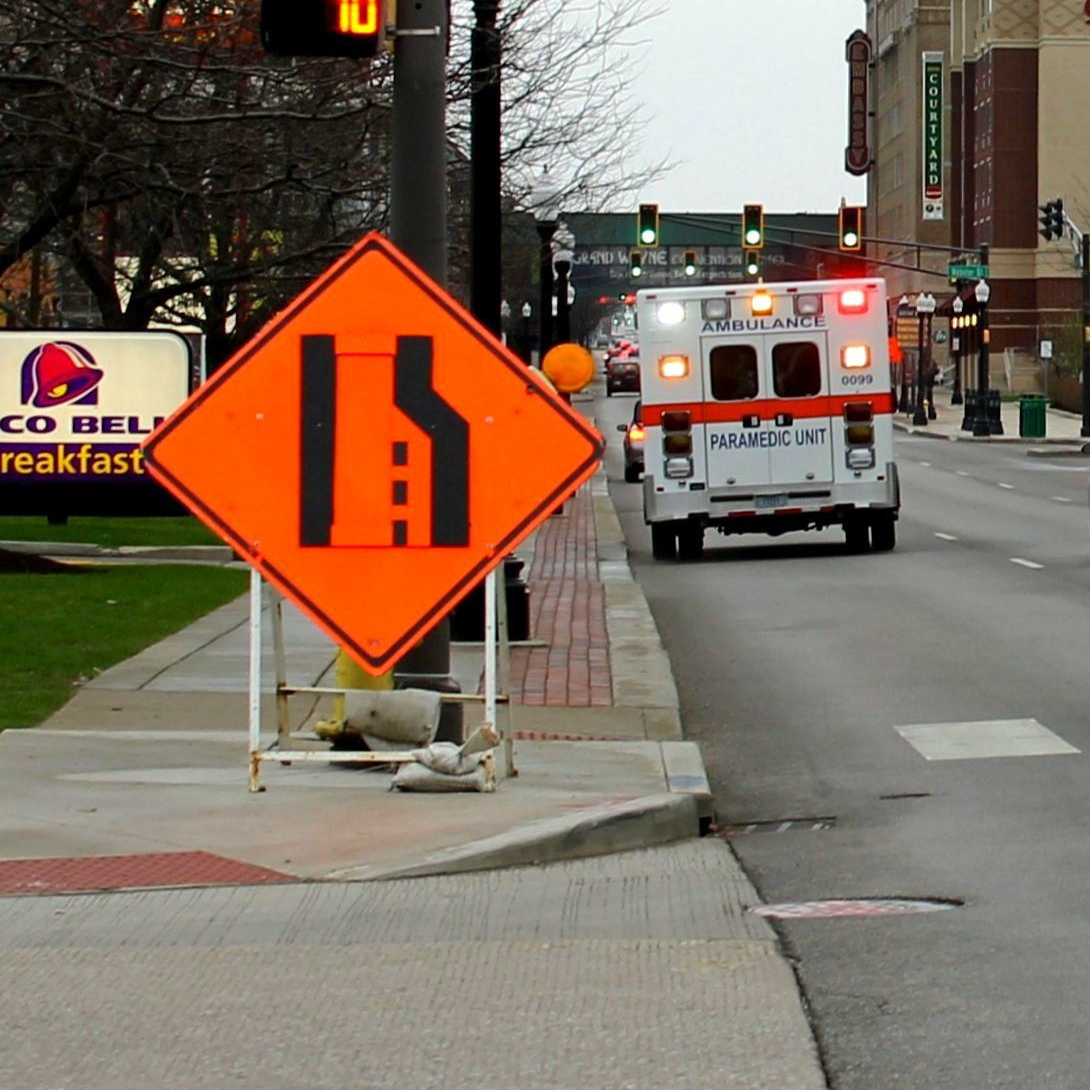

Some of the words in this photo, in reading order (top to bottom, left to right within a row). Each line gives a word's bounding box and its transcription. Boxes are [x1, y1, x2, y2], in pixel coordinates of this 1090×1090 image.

[929, 73, 939, 185] COURTYARD
[617, 250, 667, 265] WYNE
[701, 316, 826, 333] AMBULANCE
[841, 374, 873, 386] 0099
[710, 430, 791, 450] PARAMEDIC
[795, 428, 827, 446] UNIT
[1, 444, 144, 474] reakfast
